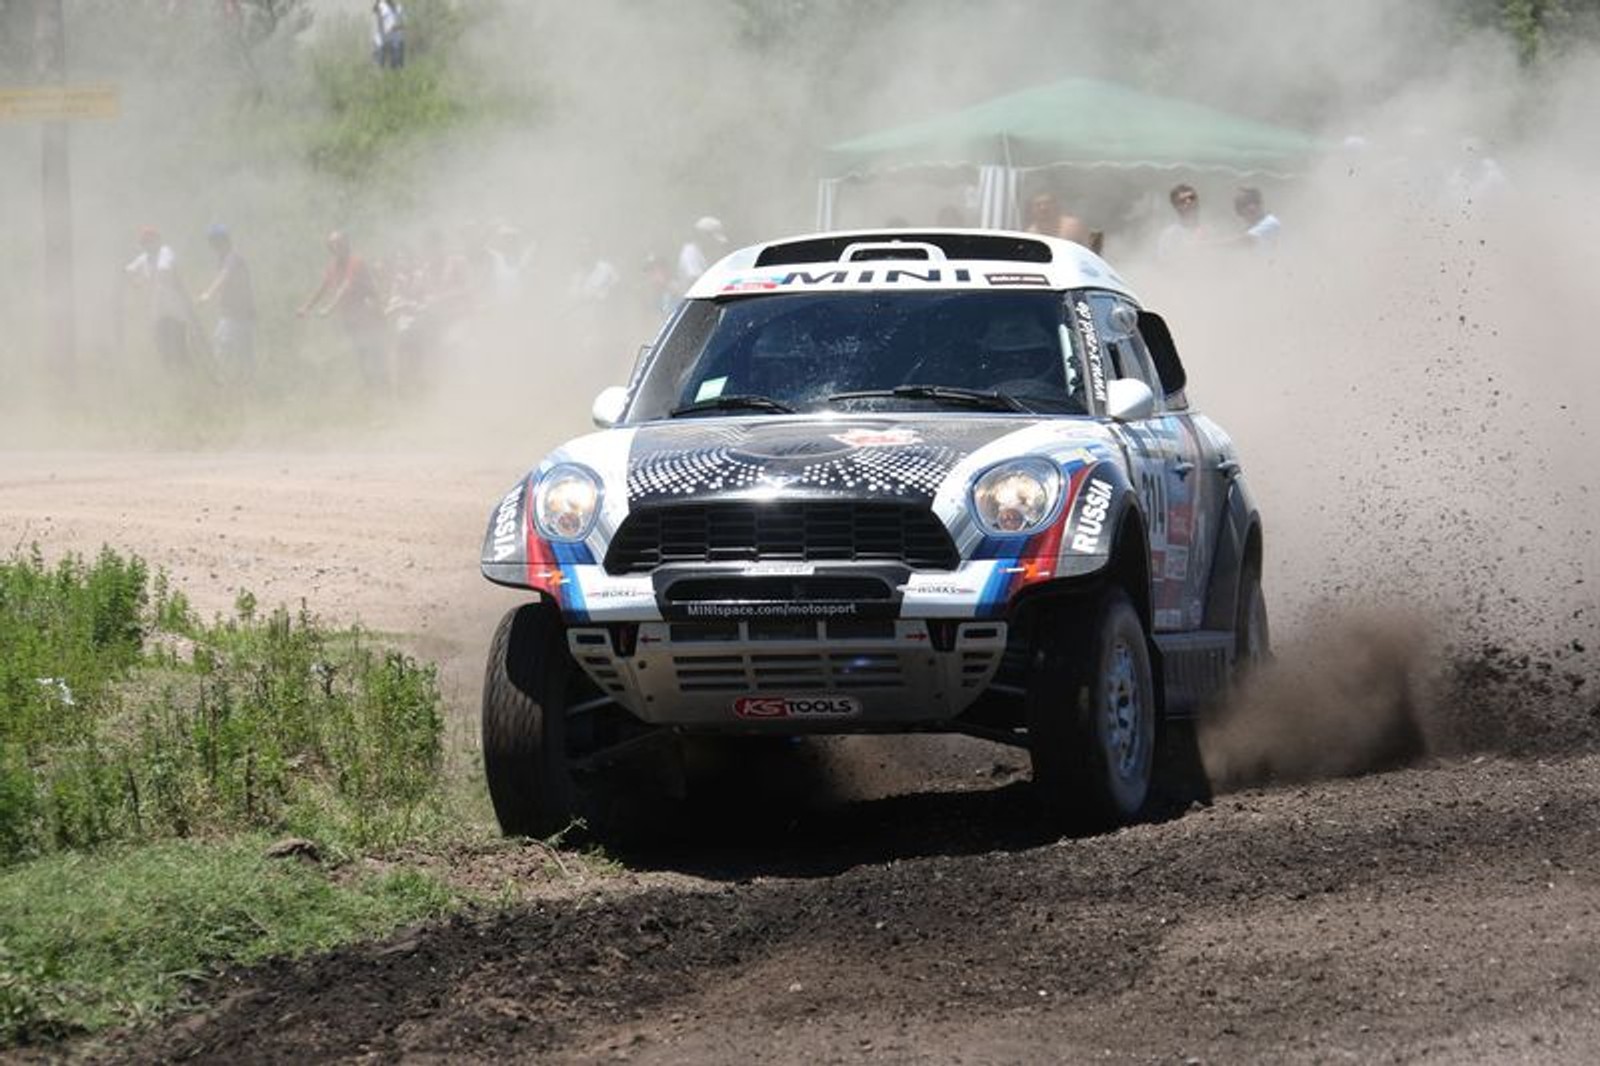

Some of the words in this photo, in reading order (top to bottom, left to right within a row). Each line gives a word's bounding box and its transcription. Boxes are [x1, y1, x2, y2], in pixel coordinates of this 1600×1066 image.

[781, 269, 972, 285] MINI
[493, 485, 524, 562] RUSSIA
[1071, 478, 1114, 554] RUSSIA
